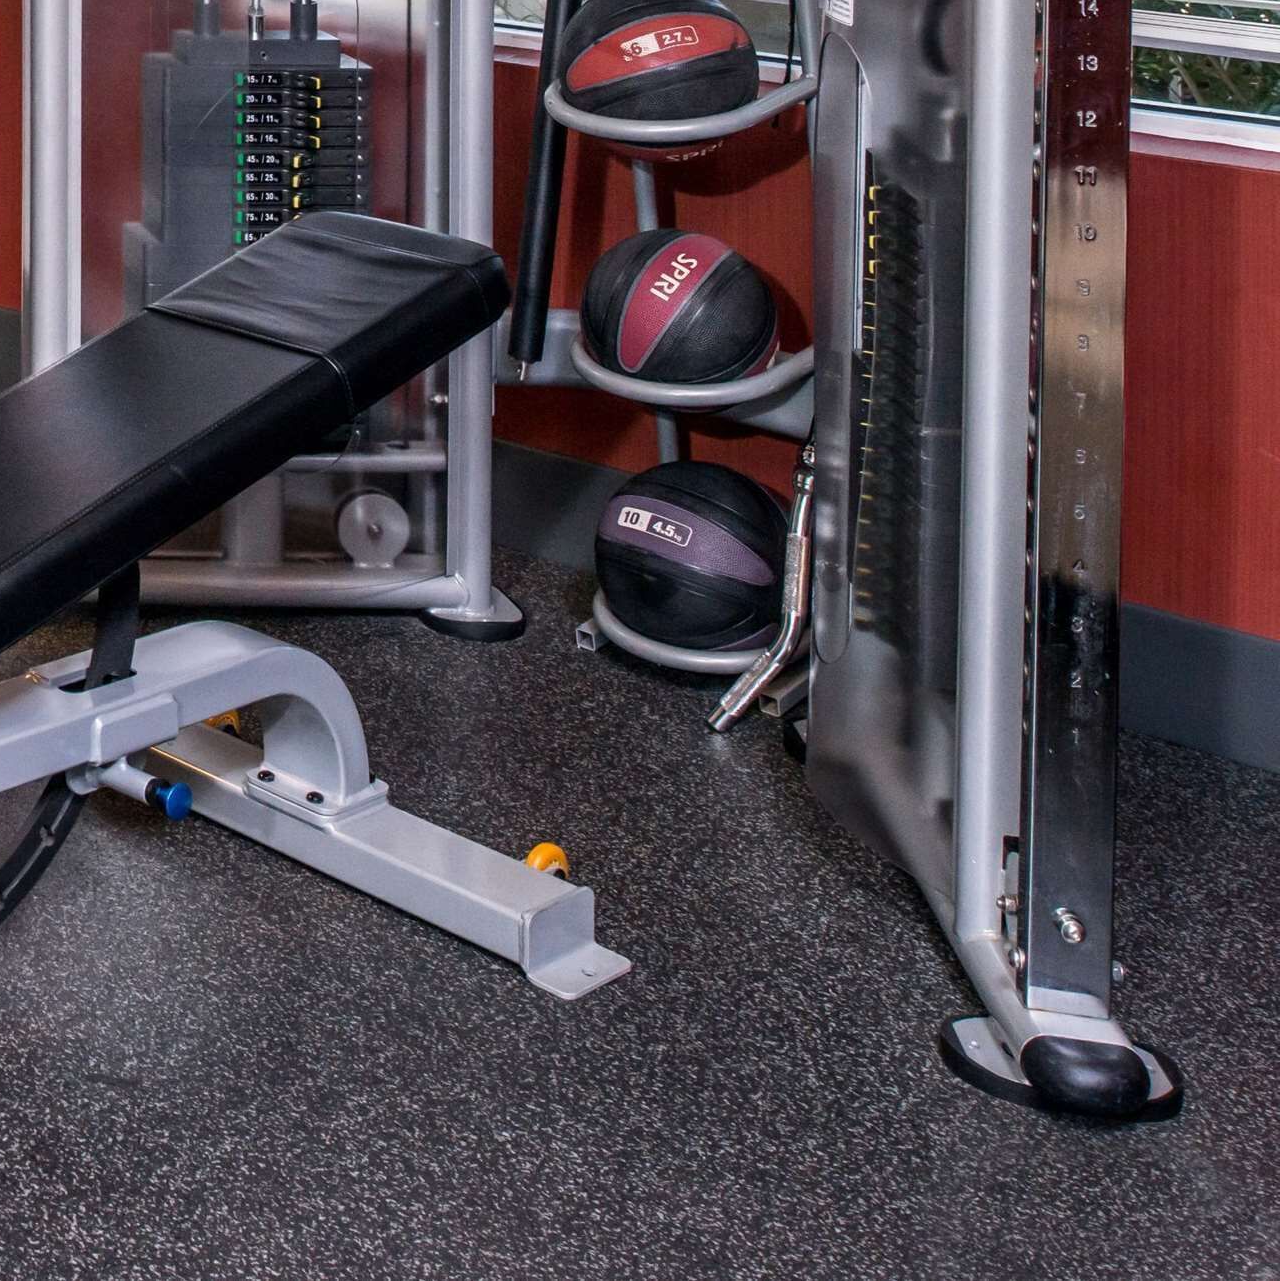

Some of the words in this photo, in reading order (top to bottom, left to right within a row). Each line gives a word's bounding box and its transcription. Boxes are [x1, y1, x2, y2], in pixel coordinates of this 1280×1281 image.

[1078, 0, 1099, 17] 14
[1077, 55, 1098, 71] 13
[1076, 111, 1097, 128] 12
[1075, 165, 1097, 186] 11
[1074, 223, 1097, 242] 10
[650, 253, 698, 302] SPRI
[623, 510, 641, 525] 10
[1074, 504, 1086, 519] 5
[1072, 558, 1085, 573] 4
[1071, 617, 1083, 633] 3
[1071, 671, 1082, 688] 2
